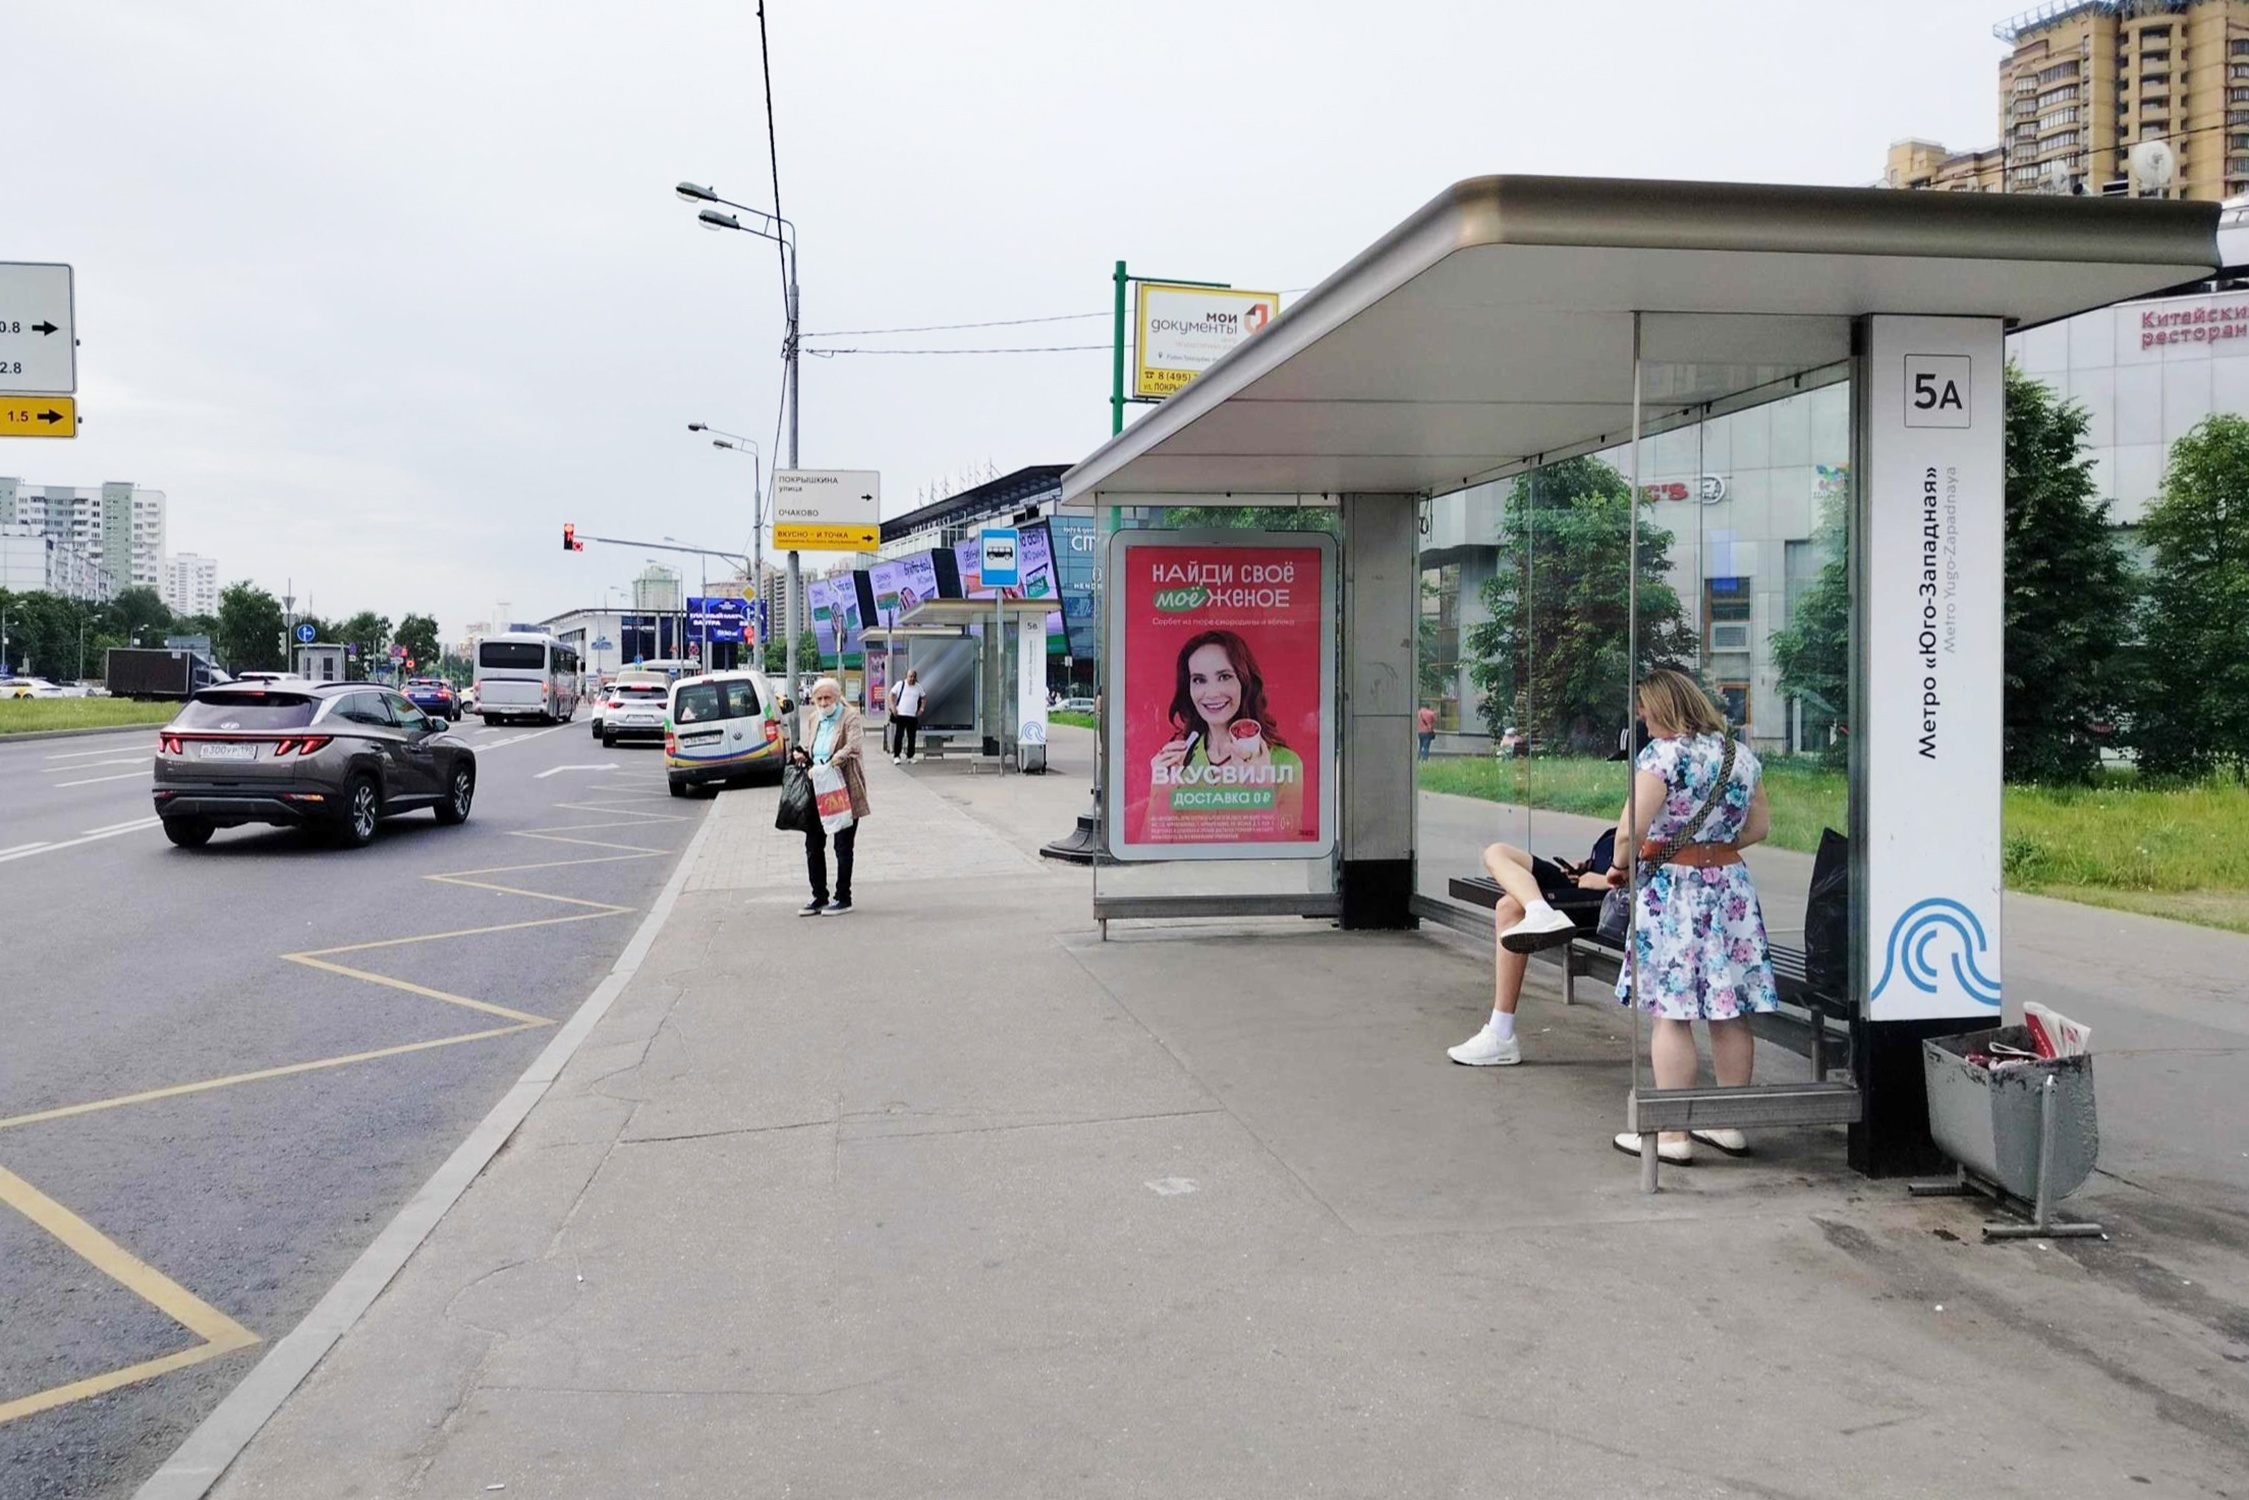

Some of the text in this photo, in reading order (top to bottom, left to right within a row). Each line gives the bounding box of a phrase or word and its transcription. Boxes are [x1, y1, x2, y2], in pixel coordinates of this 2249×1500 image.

[1206, 312, 1238, 324] мои
[2142, 306, 2249, 328] Китайски
[1151, 317, 1238, 335] документы
[2141, 324, 2248, 351] ресторан
[0, 362, 22, 374] 2.8
[1158, 371, 1191, 382] 8 (495)
[7, 410, 29, 423] 1.5
[778, 475, 839, 484] ПОКРЫШКИНА
[778, 508, 819, 517] ОЧАКОВО
[777, 530, 809, 538] ВКУСНО
[824, 531, 849, 539] ТОЧКА
[1943, 465, 1960, 654] Metro Yugo-Zapadnaya
[1152, 560, 1233, 586] НАЙДИ
[1918, 466, 1941, 760] Метро «Юго-Западная»
[1152, 617, 1181, 626] Сорбет
[1151, 764, 1294, 785] ВКУСВИЛЛ
[1173, 791, 1250, 806] ДОСТАВКА
